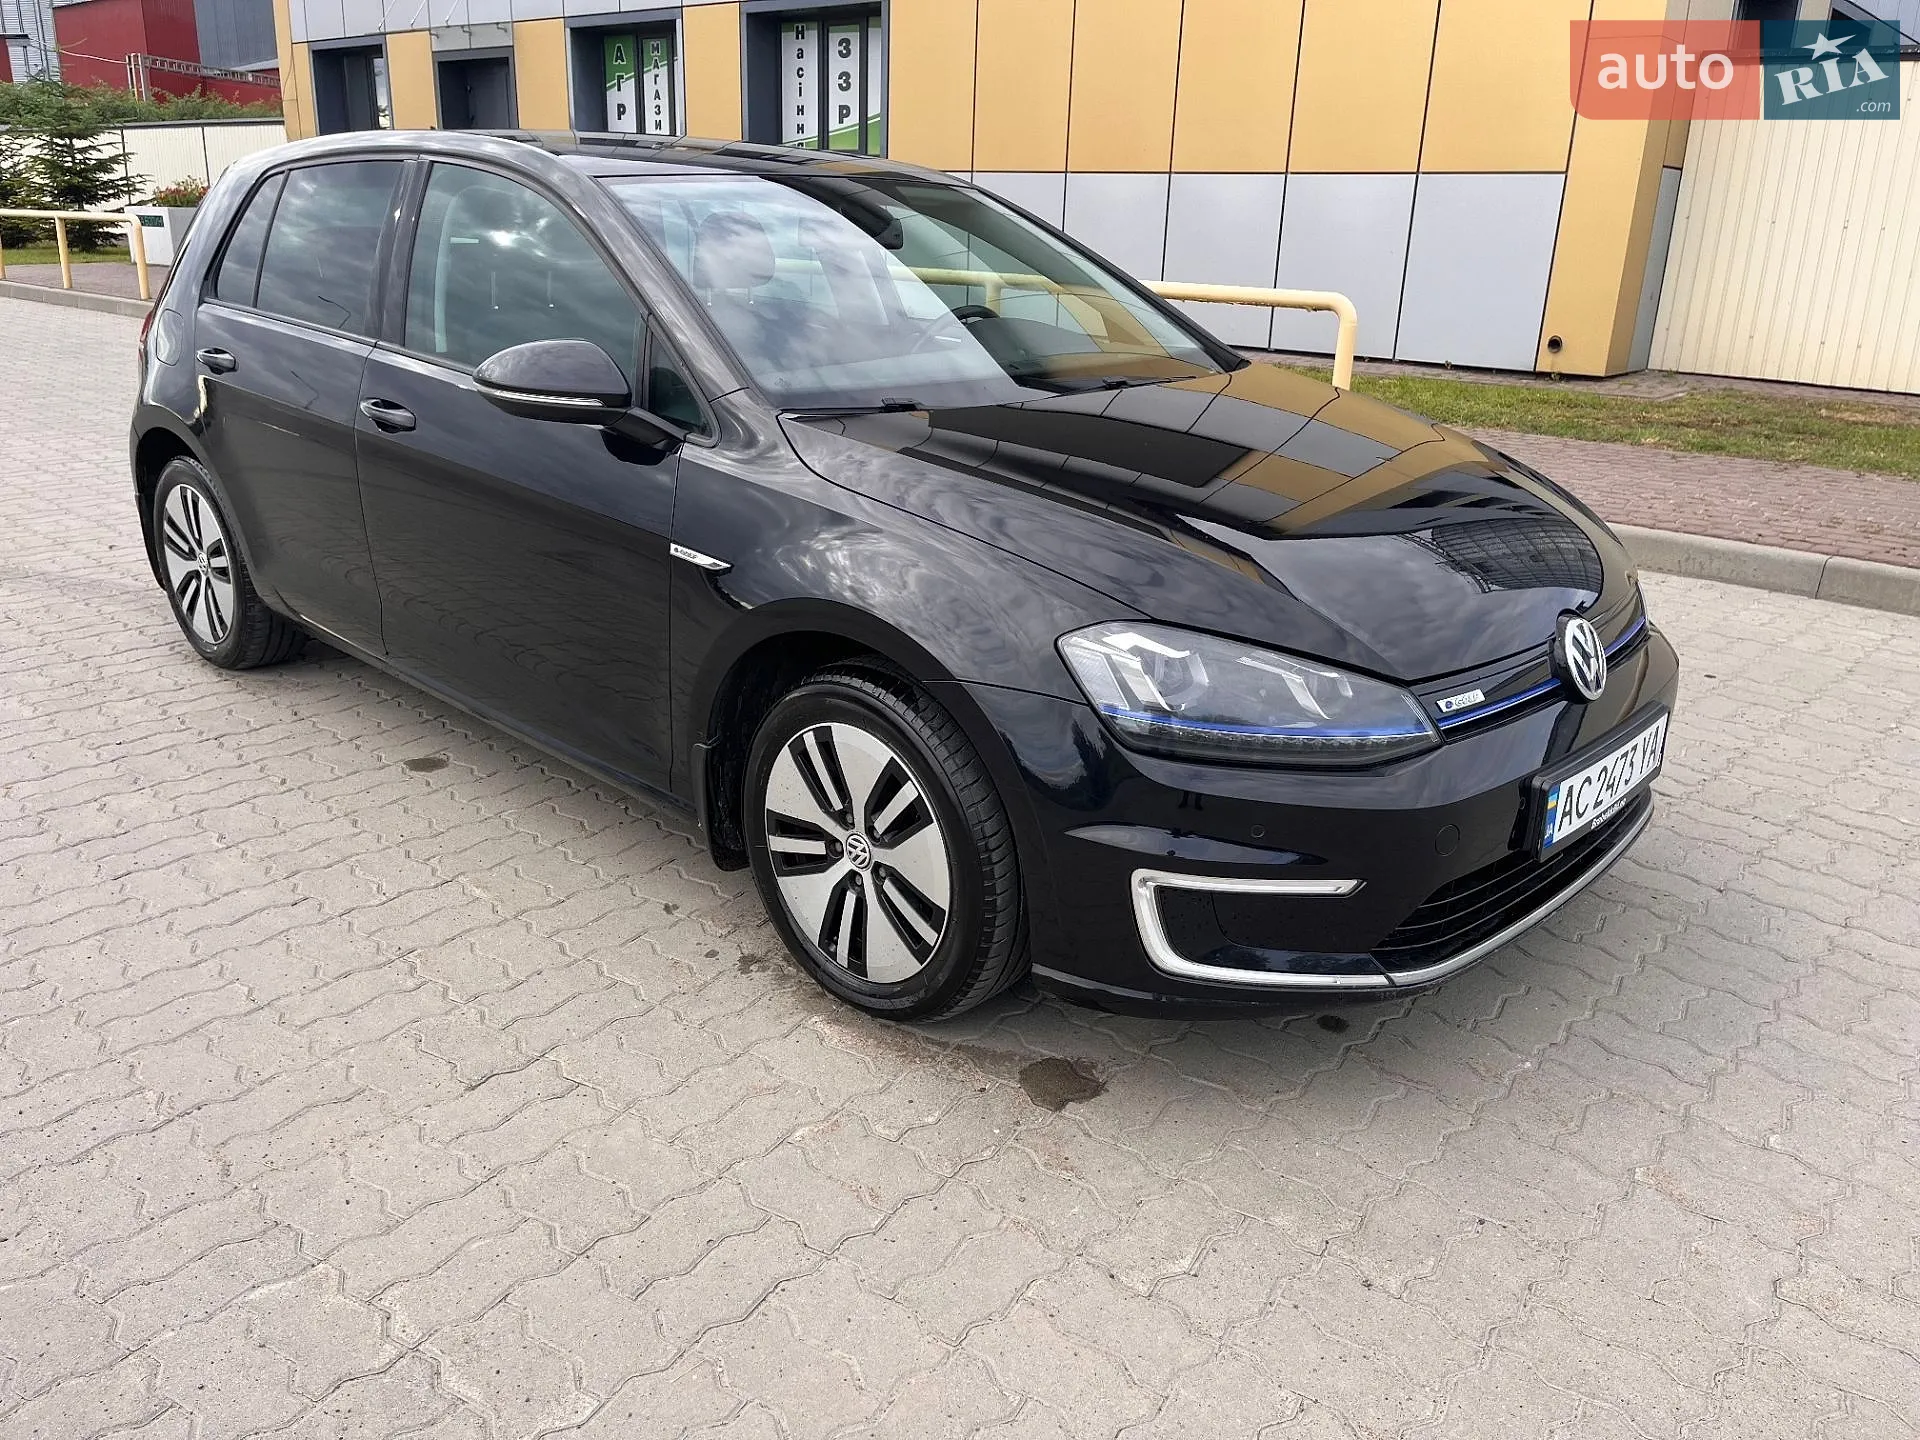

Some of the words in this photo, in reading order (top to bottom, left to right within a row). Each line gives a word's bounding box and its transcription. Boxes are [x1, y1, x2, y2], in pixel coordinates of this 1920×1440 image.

[1558, 775, 1592, 832] AC
[1592, 743, 1639, 810] 2473
[1639, 725, 1660, 775] YA
